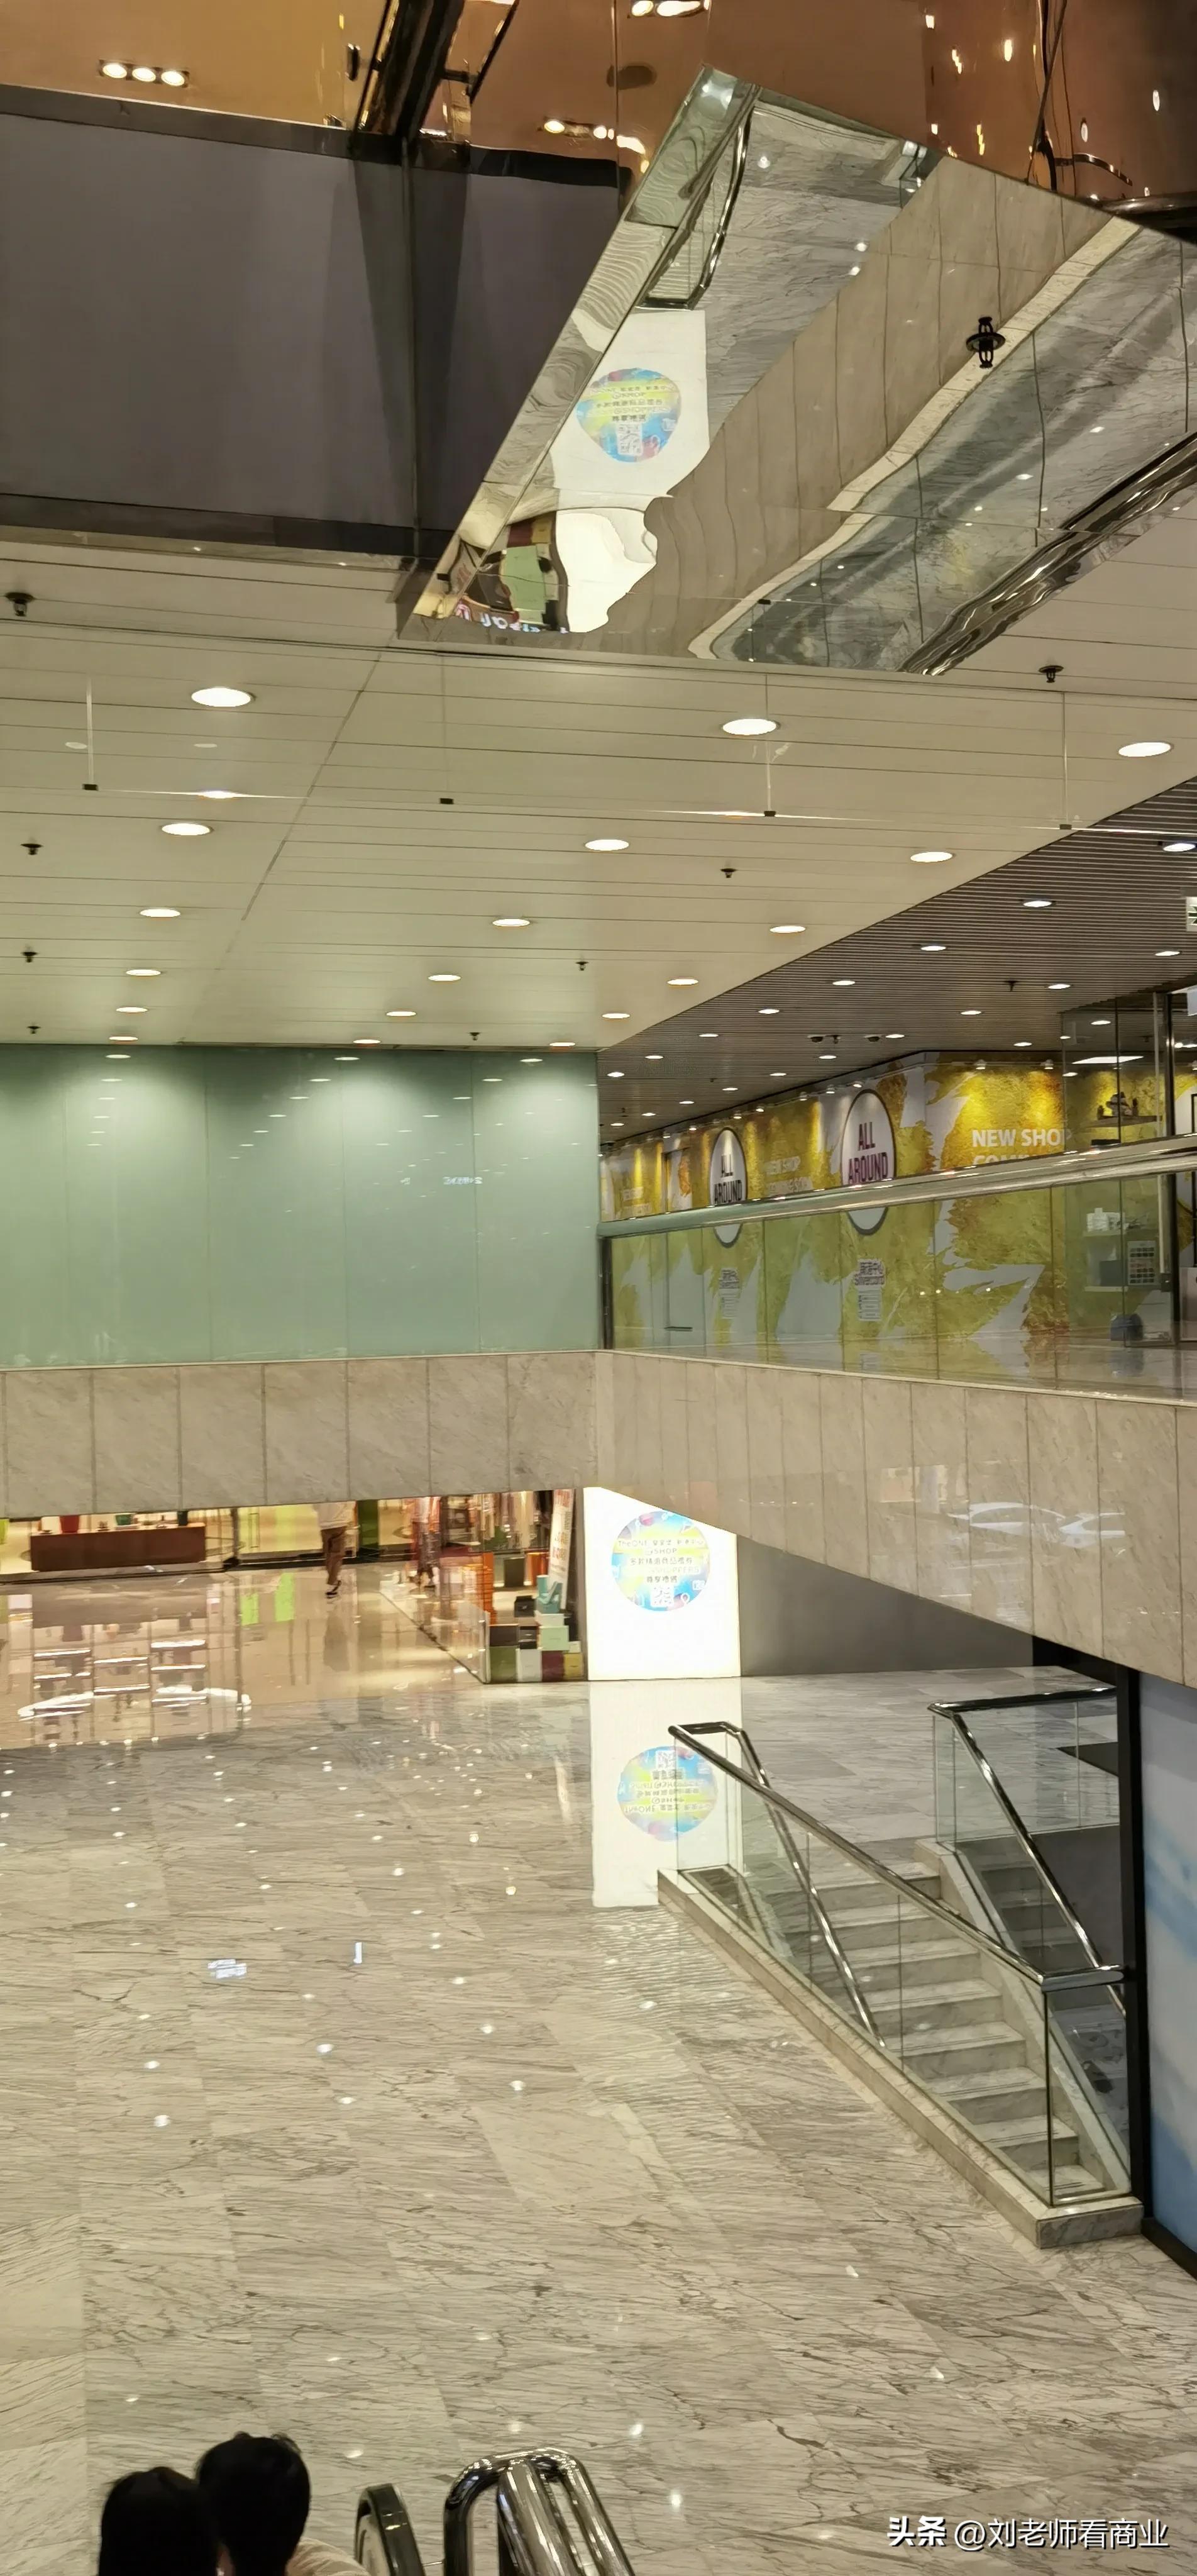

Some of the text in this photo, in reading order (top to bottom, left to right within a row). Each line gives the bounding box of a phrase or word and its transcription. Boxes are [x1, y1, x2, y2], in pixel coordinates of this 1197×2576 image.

[858, 1121, 876, 1151] ALL
[971, 1128, 1072, 1148] NEW SHOP
[847, 1152, 888, 1185] AROUND
[714, 1179, 742, 1205] AROUND
